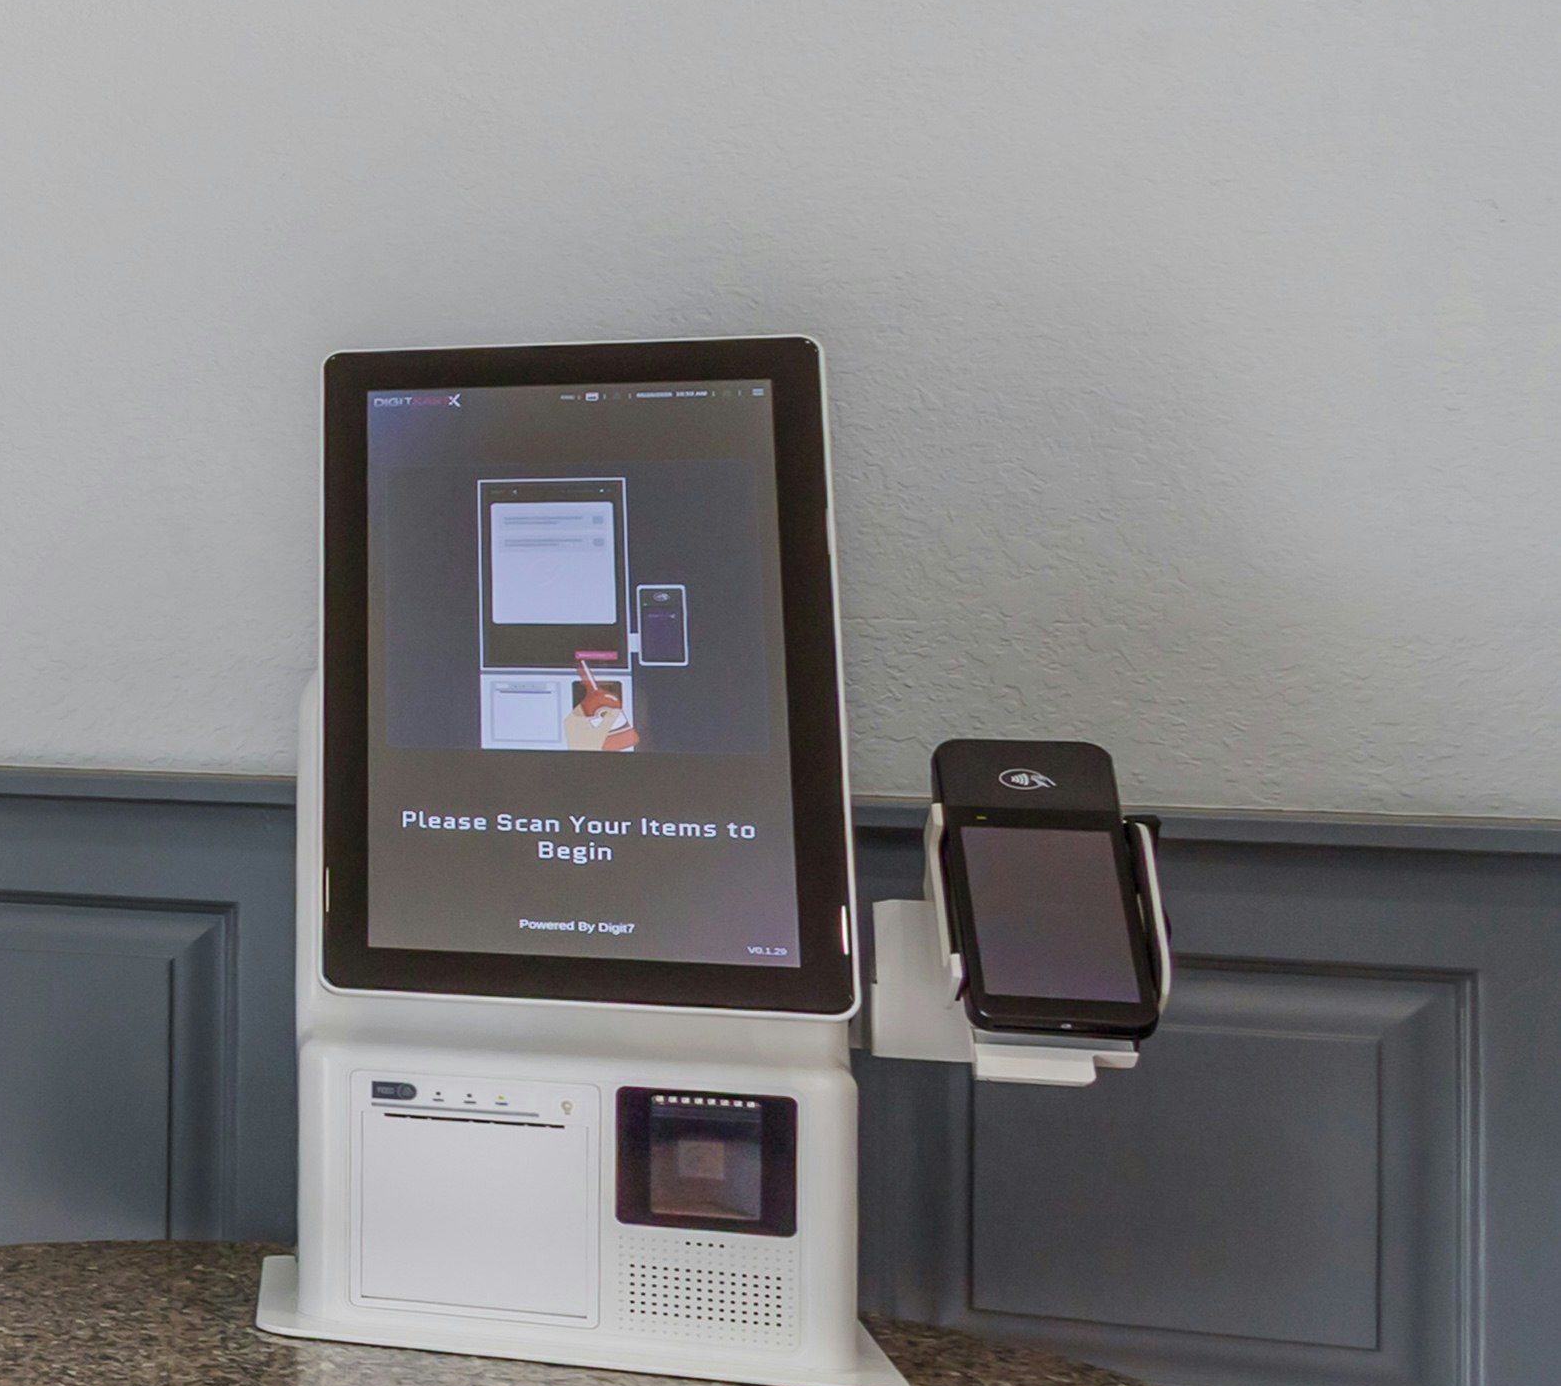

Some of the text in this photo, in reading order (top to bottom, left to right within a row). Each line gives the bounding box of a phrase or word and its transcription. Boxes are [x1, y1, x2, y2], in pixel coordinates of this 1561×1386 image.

[401, 810, 757, 840] Please Scan Your Items to
[537, 840, 613, 865] Begin
[519, 918, 636, 936] Powered By Digit7
